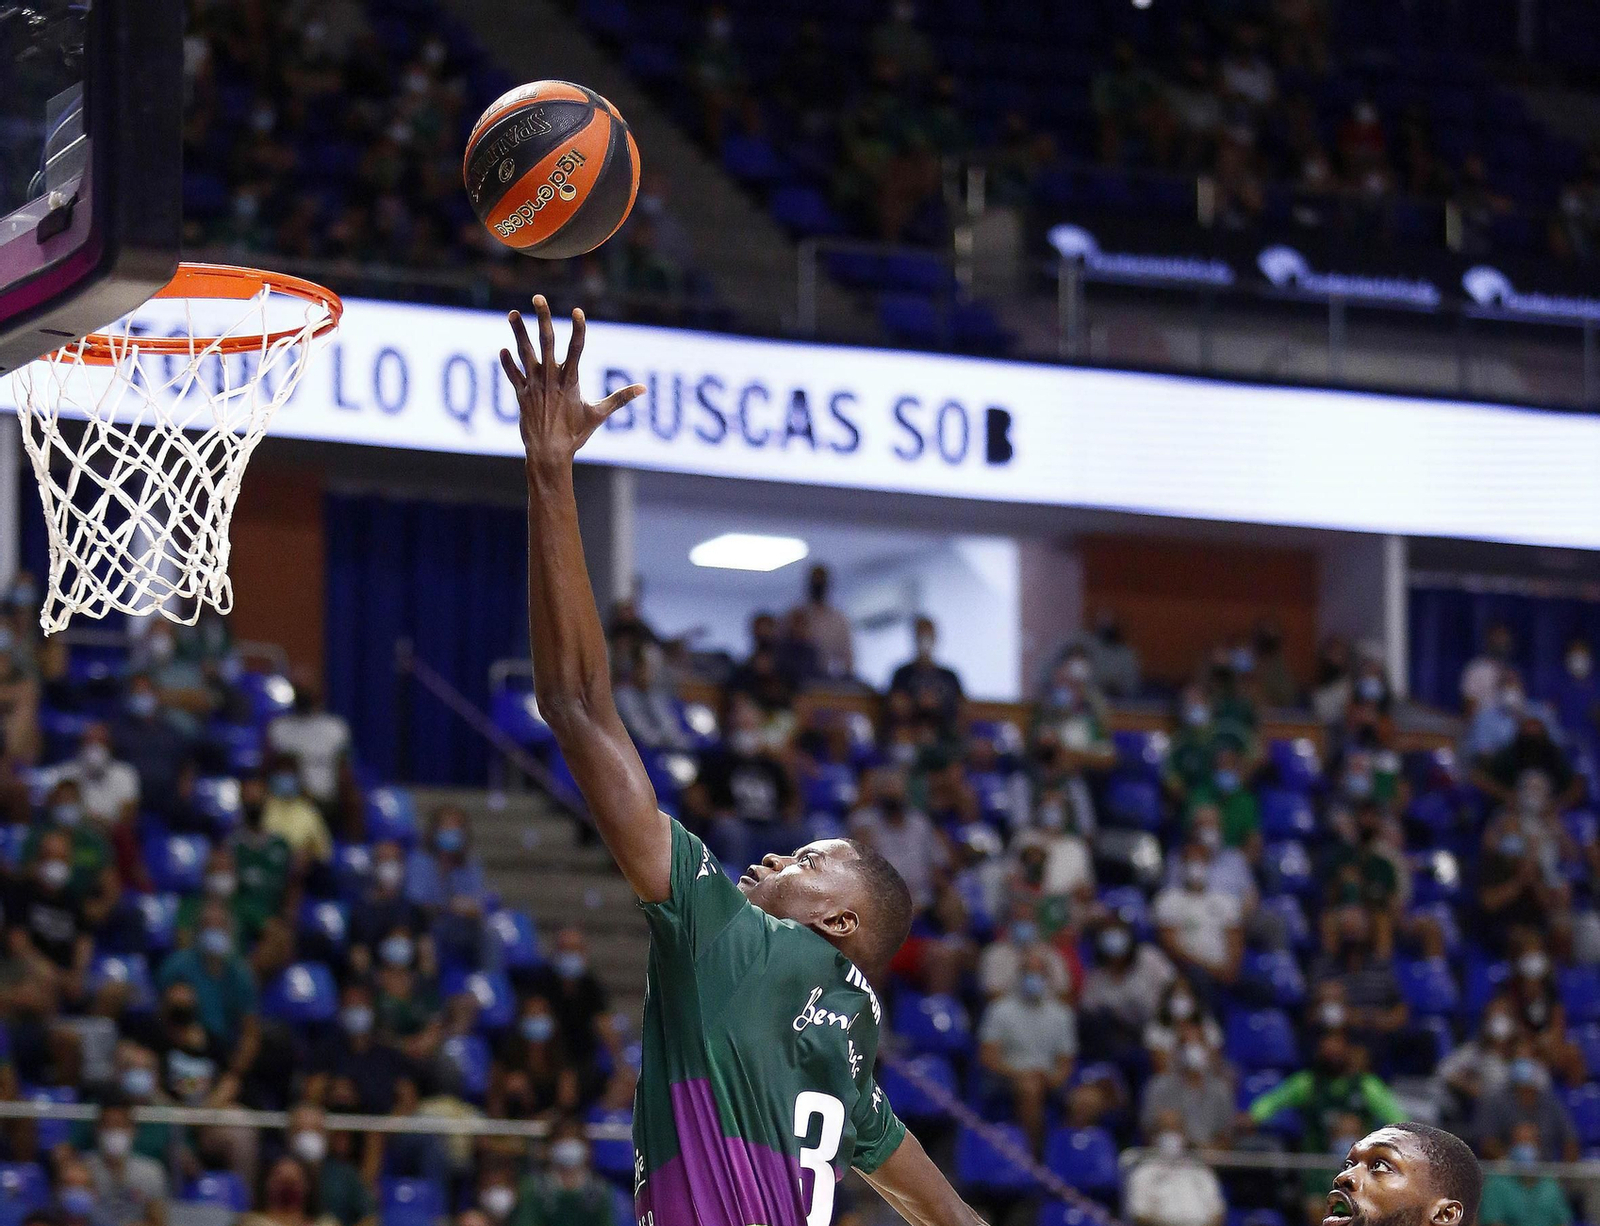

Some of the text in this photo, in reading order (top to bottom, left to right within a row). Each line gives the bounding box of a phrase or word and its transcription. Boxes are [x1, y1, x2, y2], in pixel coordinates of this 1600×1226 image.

[494, 185, 555, 238] endesa
[331, 343, 408, 415] LO
[443, 351, 519, 433] QU
[603, 368, 861, 455] BUSCAS
